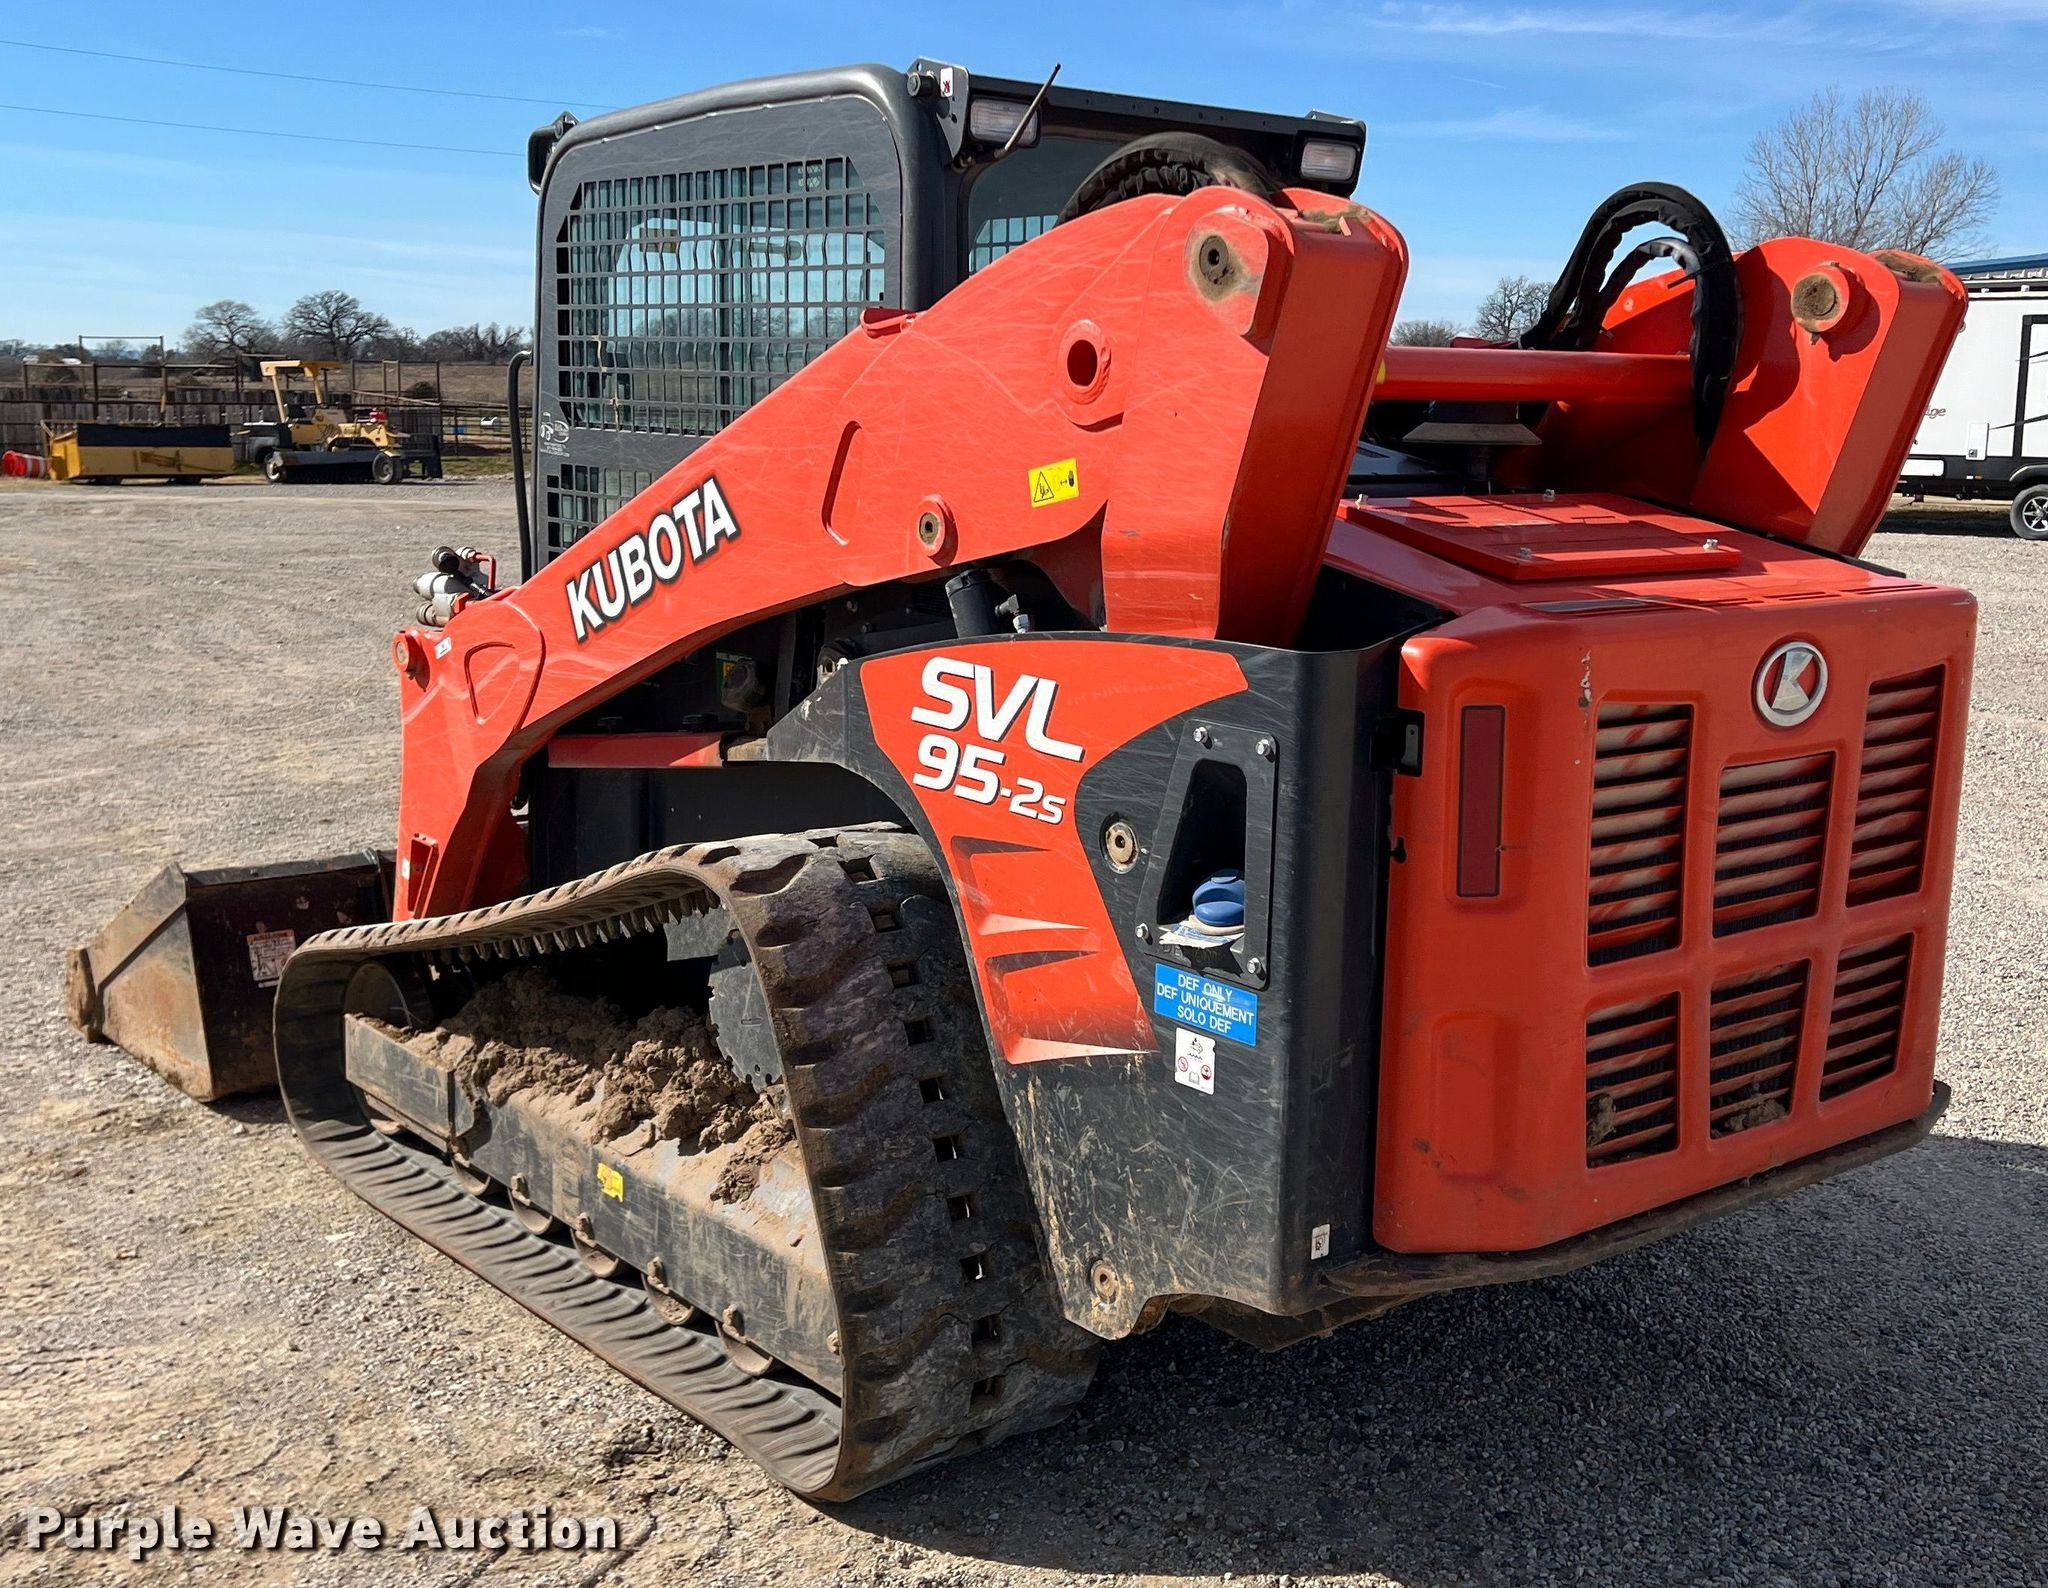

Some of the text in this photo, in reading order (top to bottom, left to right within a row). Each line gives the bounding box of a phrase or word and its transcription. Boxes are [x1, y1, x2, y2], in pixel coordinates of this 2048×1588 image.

[565, 476, 739, 641] KUBOTA
[910, 656, 1085, 763] SVL
[1157, 982, 1254, 1026] DEF UNIQUEMENT
[1178, 973, 1232, 1002] DEF ONLY
[1177, 1005, 1232, 1033] SOLO DEF
